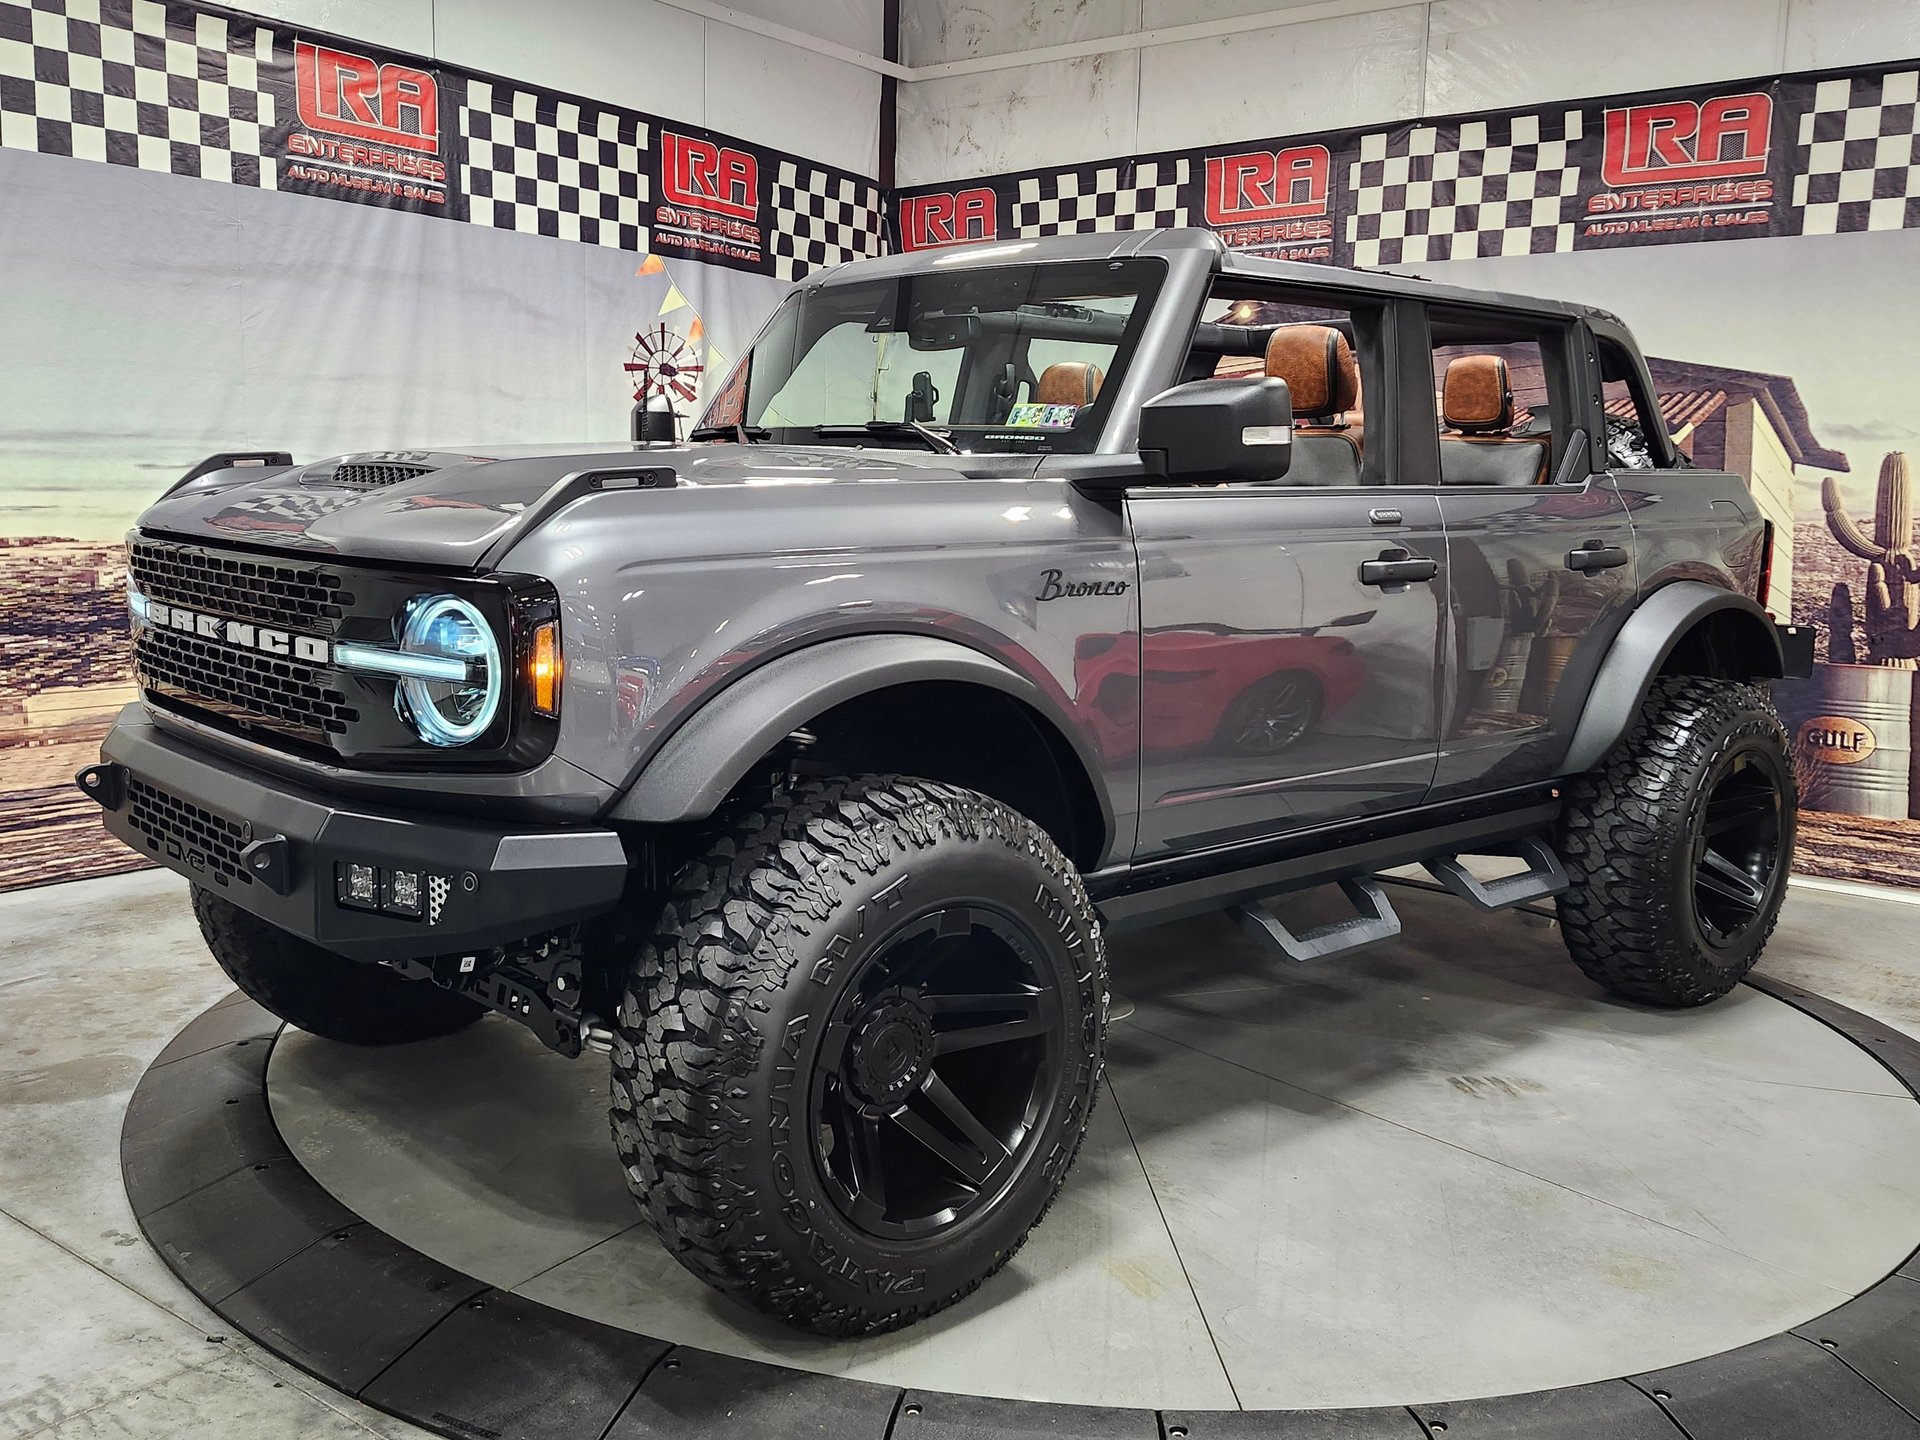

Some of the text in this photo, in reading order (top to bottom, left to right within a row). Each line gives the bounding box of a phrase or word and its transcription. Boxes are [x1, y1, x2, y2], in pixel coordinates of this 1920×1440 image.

[294, 40, 439, 155] LRA
[287, 133, 446, 180] ENTERPRISES
[1601, 92, 1774, 187] LRA
[287, 164, 445, 204] AUTO MUSEUM & SALES
[662, 130, 759, 223] LRA
[1204, 144, 1331, 226] LRA
[1587, 179, 1774, 213] ENTERPRISES
[656, 206, 760, 242] ENTERPRISES
[899, 187, 998, 253] LRA
[1217, 219, 1332, 246] TERPRISES
[1584, 210, 1770, 236] AUTO MUSEUM & SALES
[655, 232, 683, 247] AUTO
[731, 246, 761, 262] SALES
[1289, 246, 1329, 260] SALES
[1035, 568, 1132, 601] Bronco
[149, 602, 329, 664] BRONCO
[1806, 727, 1868, 754] GULF
[768, 873, 927, 1296] PATAGONIA M/T
